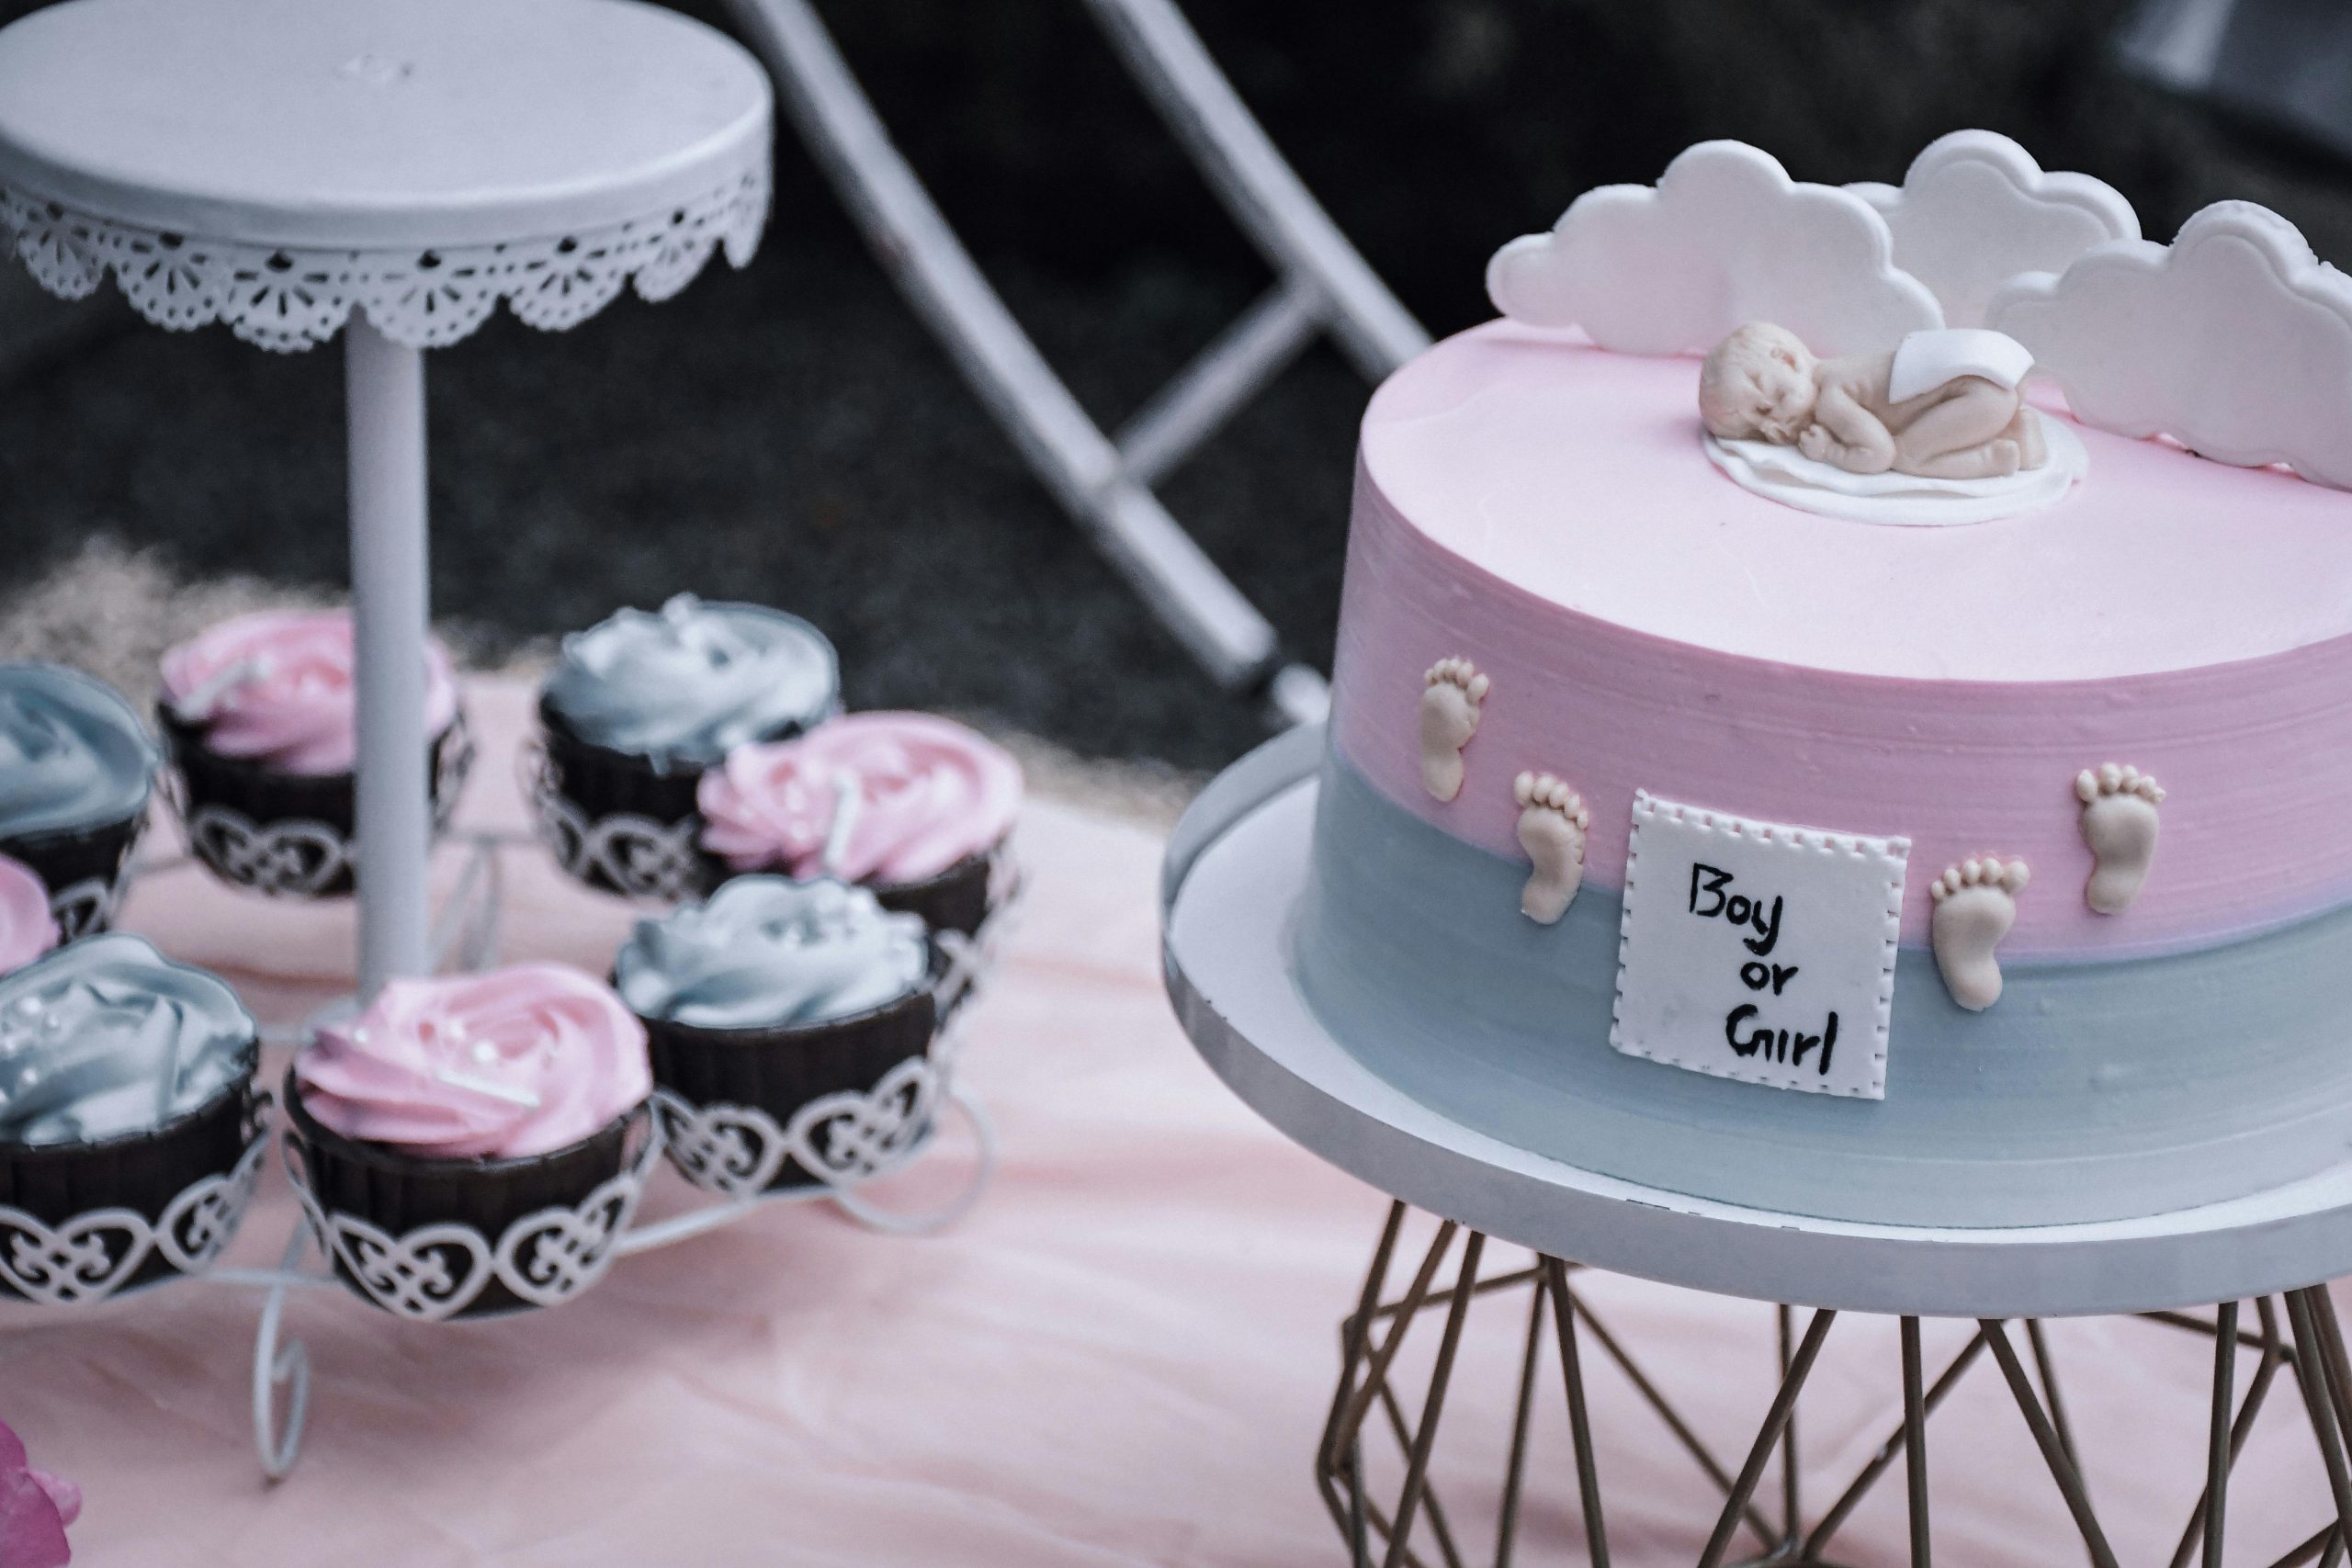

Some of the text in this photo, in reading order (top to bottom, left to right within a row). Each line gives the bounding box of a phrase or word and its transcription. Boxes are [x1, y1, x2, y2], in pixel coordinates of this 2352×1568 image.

[1688, 862, 1784, 957] Boy
[1739, 961, 1800, 997] or
[1724, 1002, 1839, 1077] Girl
